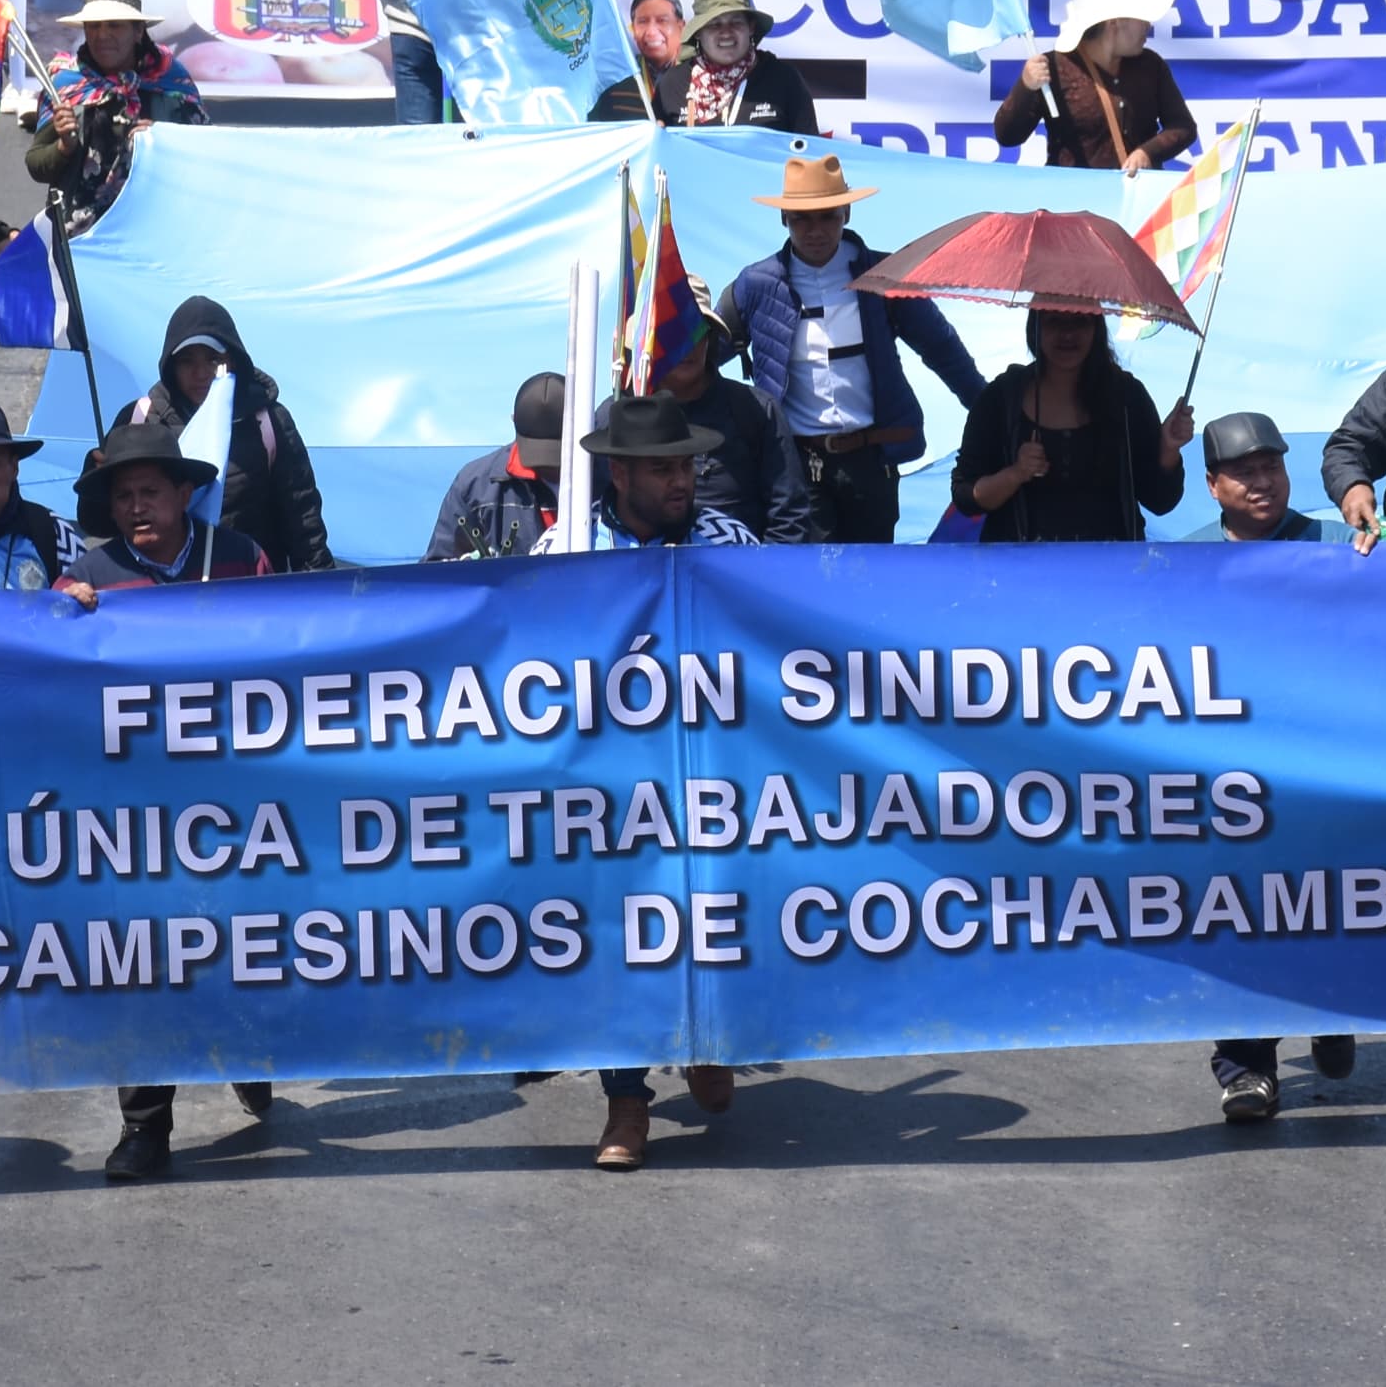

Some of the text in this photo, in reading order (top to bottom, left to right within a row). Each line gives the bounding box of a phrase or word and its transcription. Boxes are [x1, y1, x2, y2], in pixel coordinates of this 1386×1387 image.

[103, 635, 1244, 754] FEDERACIÓN SINDICAL
[6, 770, 1266, 880] ÚNICA DE TRABAJADORES
[623, 892, 742, 964] DE
